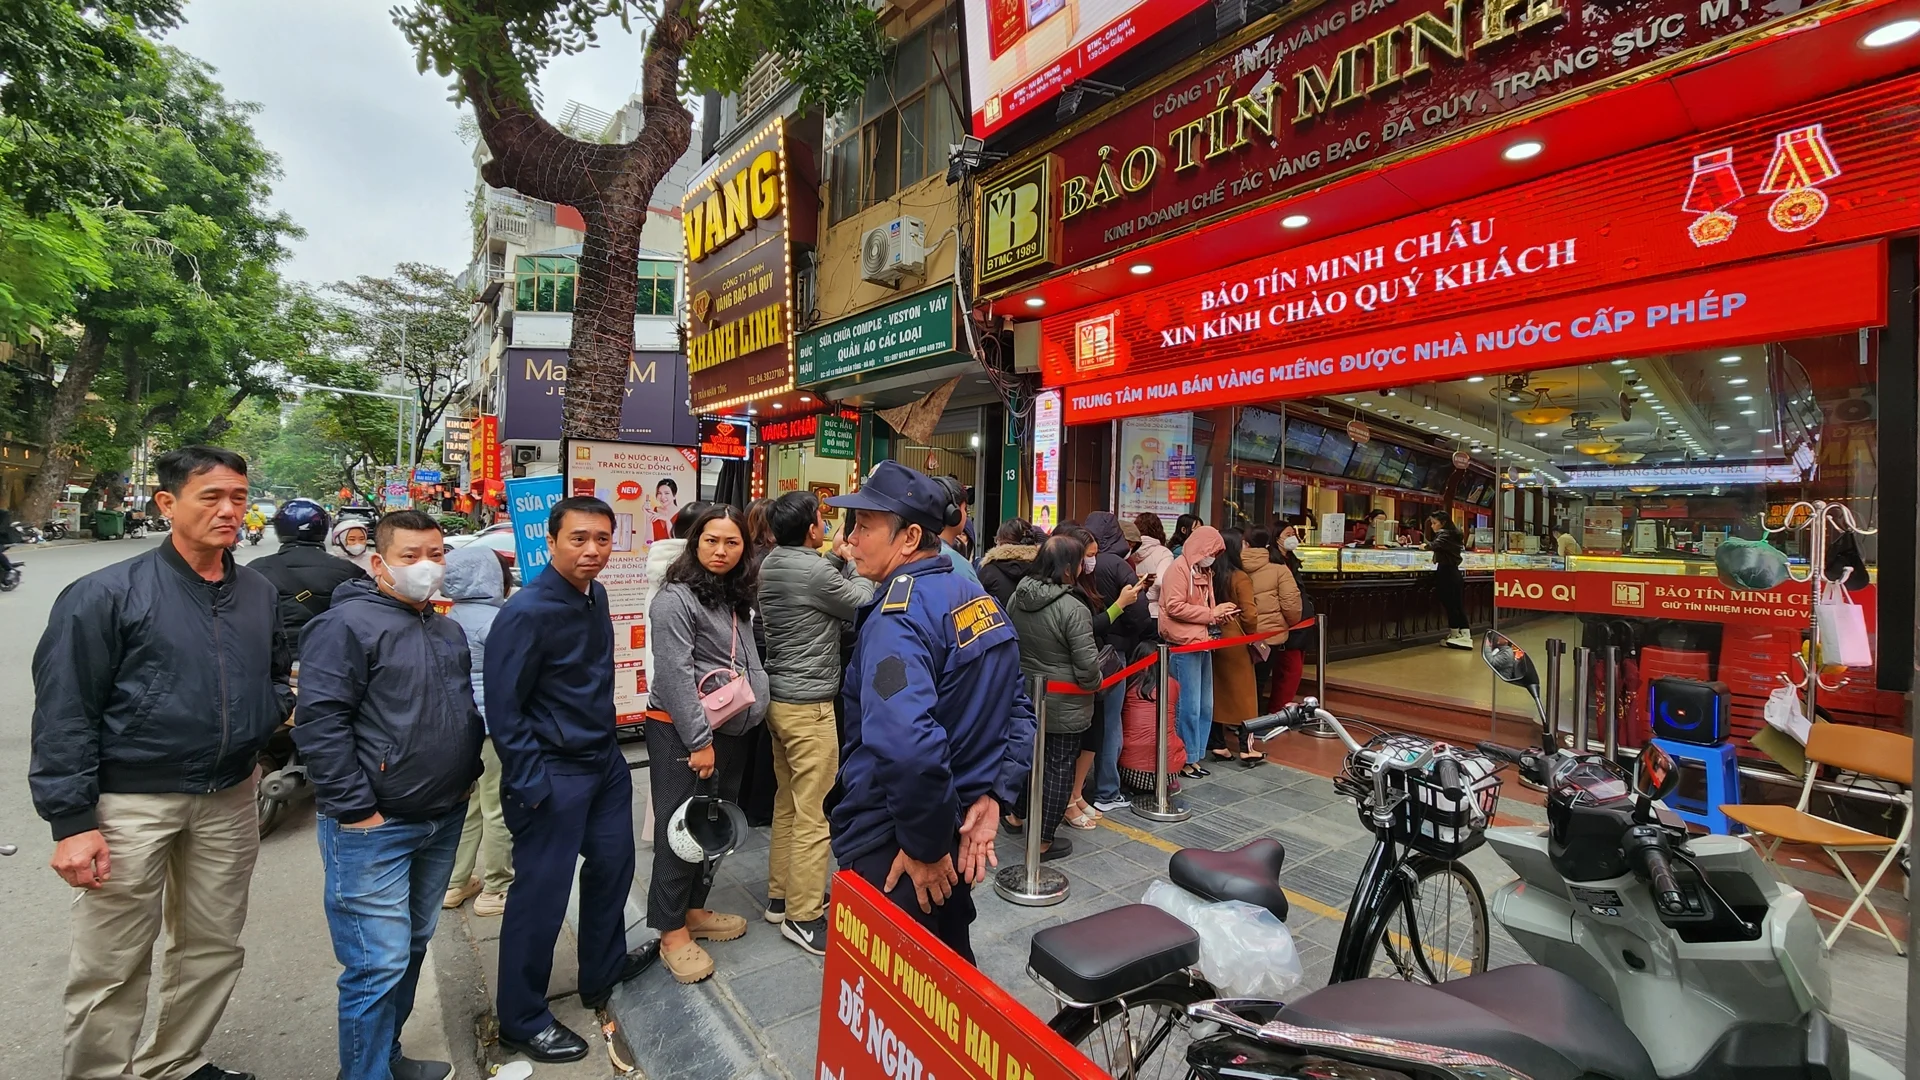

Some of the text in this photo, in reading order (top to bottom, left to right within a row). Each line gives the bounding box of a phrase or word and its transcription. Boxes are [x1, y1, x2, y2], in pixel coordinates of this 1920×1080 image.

[1152, 0, 1398, 120] CÔNG TY TNHH VÀNG BẠ
[1103, 217, 1135, 243] KINH
[1137, 198, 1190, 231] DOANH
[1192, 179, 1226, 211] CHẾ
[1230, 169, 1264, 197] TÁC
[1267, 149, 1321, 181] VÀNG
[1382, 110, 1416, 142] ĐÁ
[1493, 49, 1599, 101] TRANG
[1612, 13, 1686, 58] SỨC
[1059, 145, 1160, 222] BẢO
[1168, 86, 1282, 173] TÍN
[685, 150, 779, 262] VÀNG
[986, 242, 1037, 271] BTMC 1989
[1201, 217, 1496, 312] BẢO TÍN MINH CHÂU
[715, 291, 733, 313] VÀNG
[733, 286, 747, 306] BẠC
[758, 269, 774, 294] QUÝ
[722, 262, 765, 291] CÔNG TY TNHH
[1160, 237, 1578, 348] XIN KÍNH CHÀO QUÝ KHÁCH
[819, 294, 948, 348] SỬA CHỮA COMPLE VESTON VÁY
[690, 302, 782, 374] KHÁNH LINH
[800, 343, 813, 358] ĐỨC
[838, 326, 922, 362] QUẦN ÁO CÁC LOẠI
[1072, 289, 1747, 411] TRUNG TÂM MUA BÁN VÀNG MIẾNG ĐƯỢC NHÀ NƯỚC CẤP PHÉP
[800, 362, 813, 376] HẬU
[761, 422, 788, 441] VÀNG
[614, 452, 670, 462] BỘ NƯỚC RỬA
[647, 463, 671, 471] ĐỒNG
[673, 463, 685, 472] HỒ
[681, 448, 697, 464] MỚI
[779, 478, 798, 491] TRANG
[1006, 470, 1015, 480] 13
[1613, 469, 1649, 477] TRANG
[516, 492, 544, 512] SỬA
[621, 486, 639, 494] NEW
[1655, 584, 1691, 598] BẢO
[1694, 587, 1725, 601] TÍN
[1730, 589, 1782, 604] MINH
[1661, 601, 1798, 617] GIỮ TÍN NHIỆM HƠN GIỮ
[836, 902, 869, 957] CÔNG
[871, 933, 890, 977] AN
[893, 956, 960, 1044] PHƯỜNG
[965, 1013, 1000, 1080] HAI
[838, 975, 865, 1042] ĐỀ
